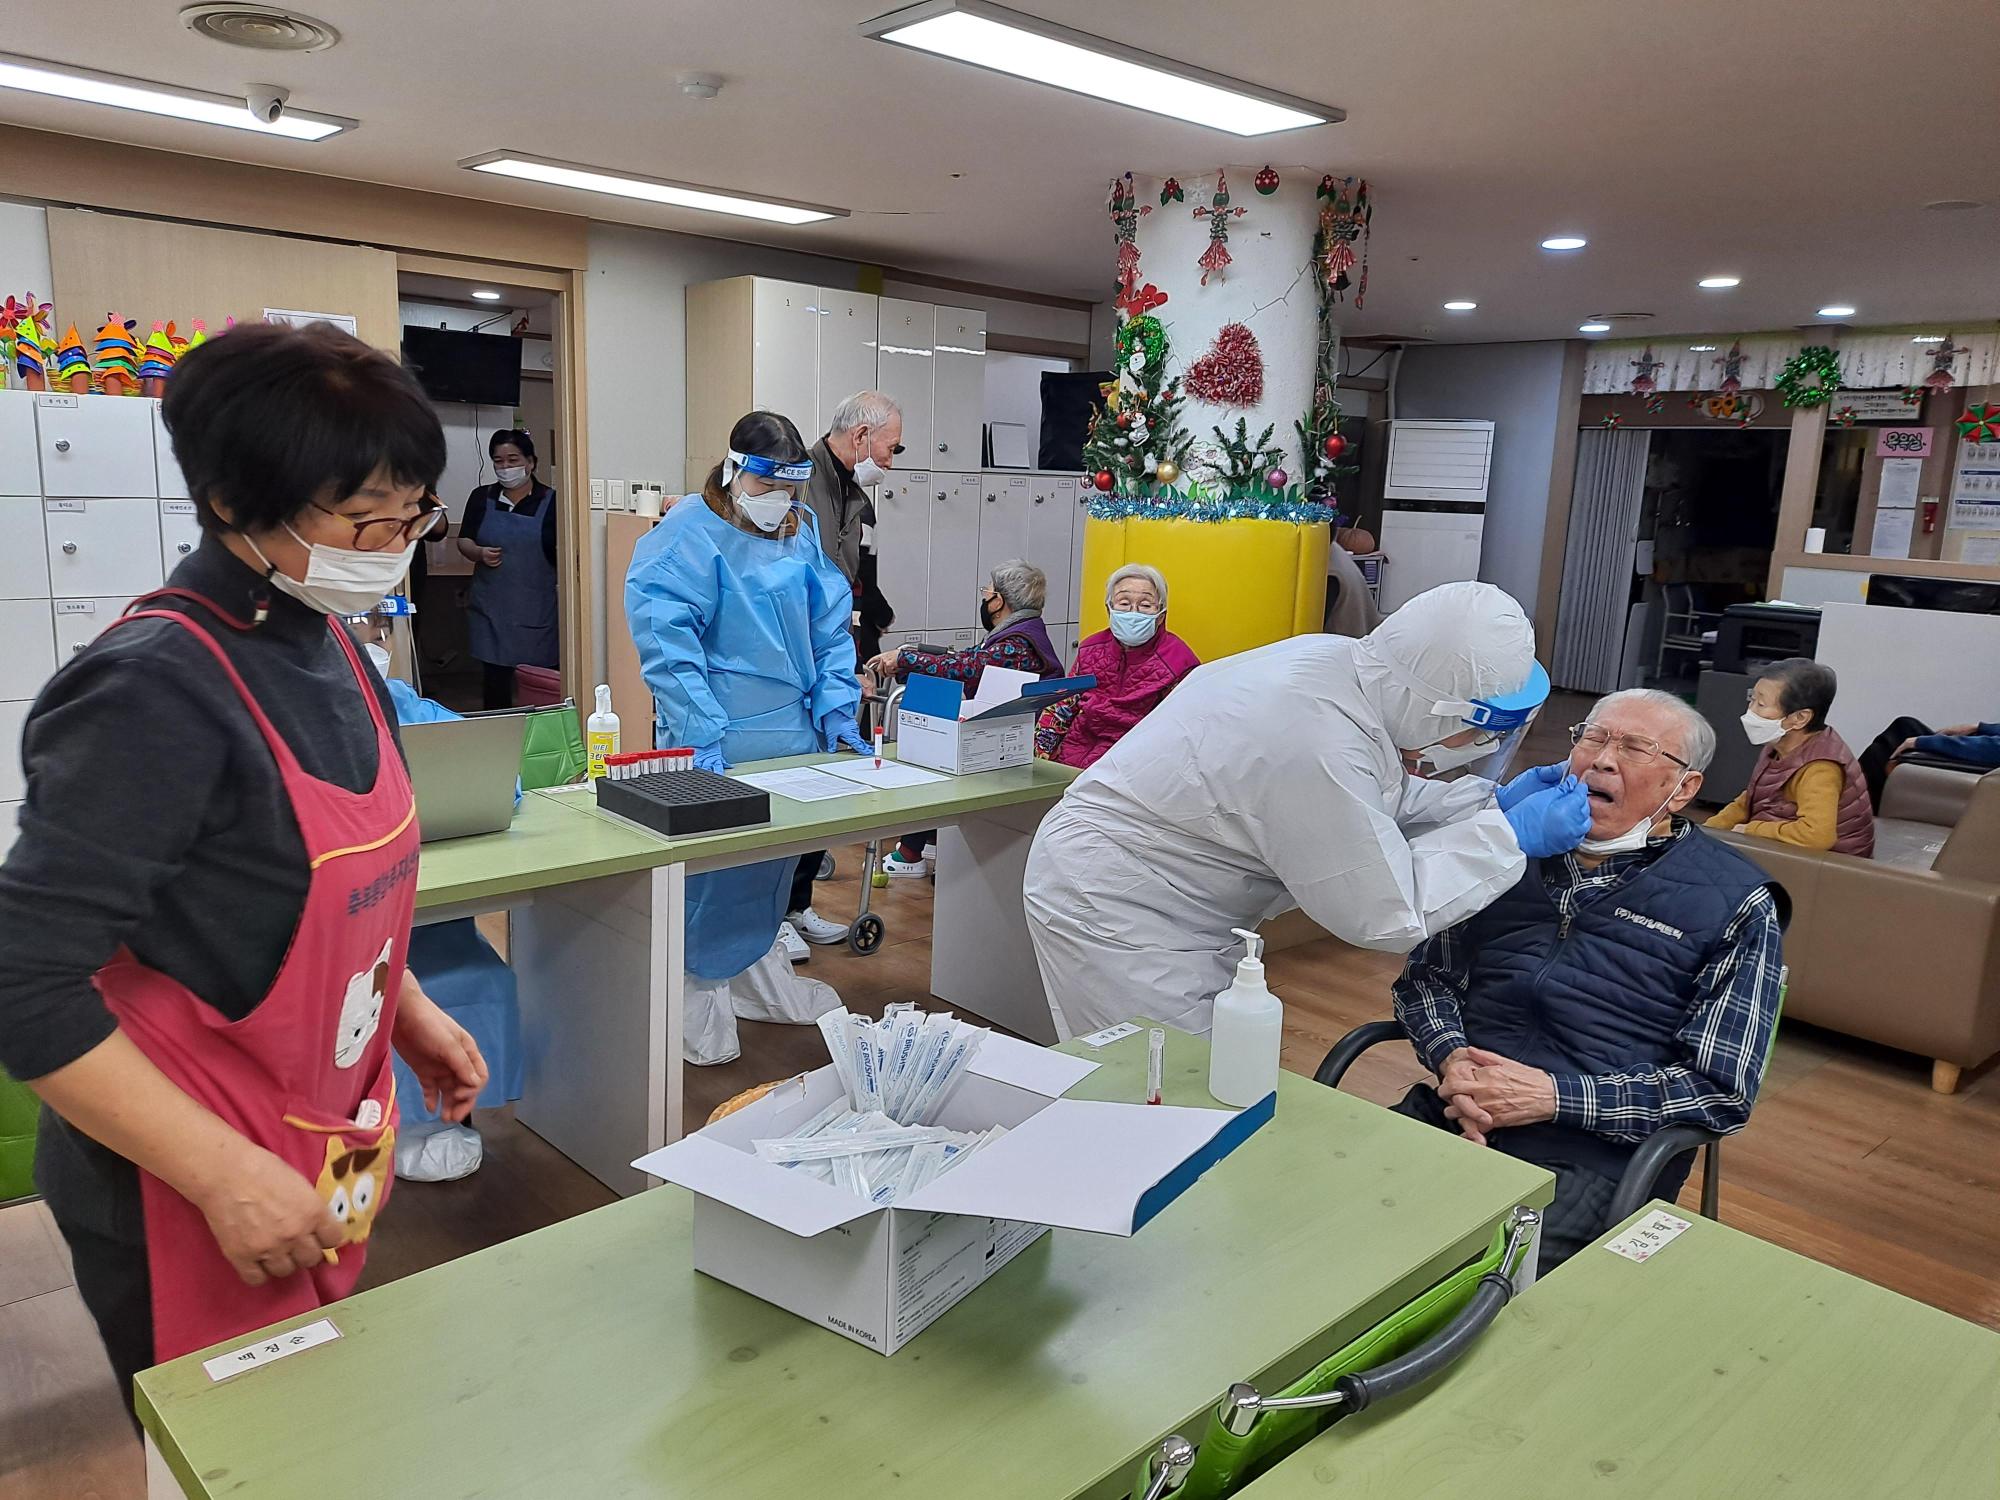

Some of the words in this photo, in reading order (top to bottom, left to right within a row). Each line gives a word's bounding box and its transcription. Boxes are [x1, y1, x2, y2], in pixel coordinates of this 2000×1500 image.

[785, 298, 790, 306] 1
[848, 307, 853, 316] 2
[899, 1038, 913, 1065] BRUSH
[863, 1052, 873, 1078] BRUSH
[827, 1315, 847, 1331] MADE
[847, 1324, 855, 1334] IN
[855, 1328, 877, 1343] KOREA
